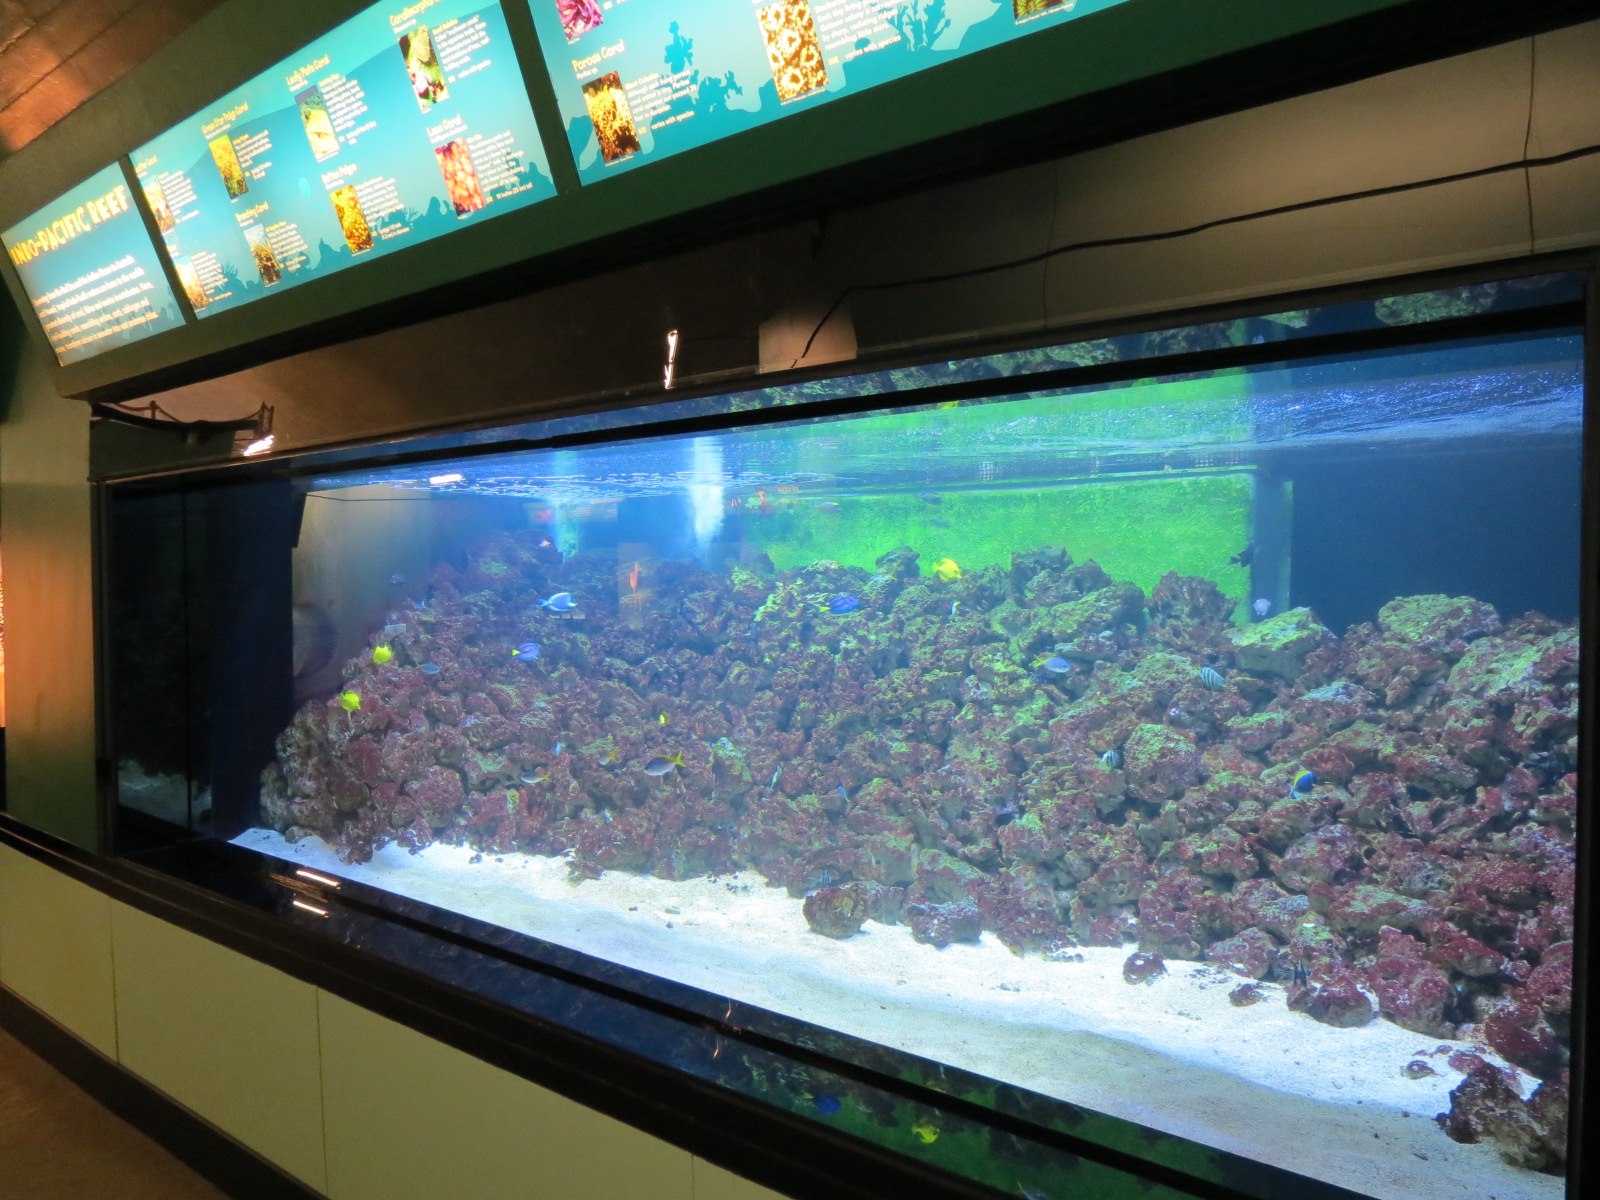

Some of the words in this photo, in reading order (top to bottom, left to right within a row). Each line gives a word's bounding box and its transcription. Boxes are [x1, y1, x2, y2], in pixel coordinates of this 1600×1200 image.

[817, 10, 832, 22] Each
[832, 8, 844, 18] tiny
[844, 11, 865, 24] colony
[822, 33, 830, 43] by
[830, 26, 850, 40] sharp,
[878, 8, 898, 21] ridges
[572, 52, 602, 72] Porous
[600, 38, 626, 59] Coral
[828, 55, 840, 66] SIZE
[845, 48, 864, 60] varies
[864, 42, 878, 53] with
[878, 34, 902, 50] species
[313, 54, 330, 70] Coral
[628, 86, 649, 98] Although
[673, 69, 692, 82] porous
[234, 101, 249, 115] Coral
[630, 97, 642, 108] coral
[641, 90, 656, 102] animal
[632, 106, 644, 116] coral
[644, 99, 664, 111] colonies
[662, 95, 673, 104] can
[672, 86, 690, 100] exceed
[689, 84, 698, 93] 20
[442, 113, 462, 130] Coral
[634, 112, 646, 122] feet
[651, 120, 666, 130] varies
[666, 116, 677, 126] with
[676, 110, 695, 122] species
[10, 206, 91, 265] INDO-PACIFIC
[86, 184, 128, 224] REEF
